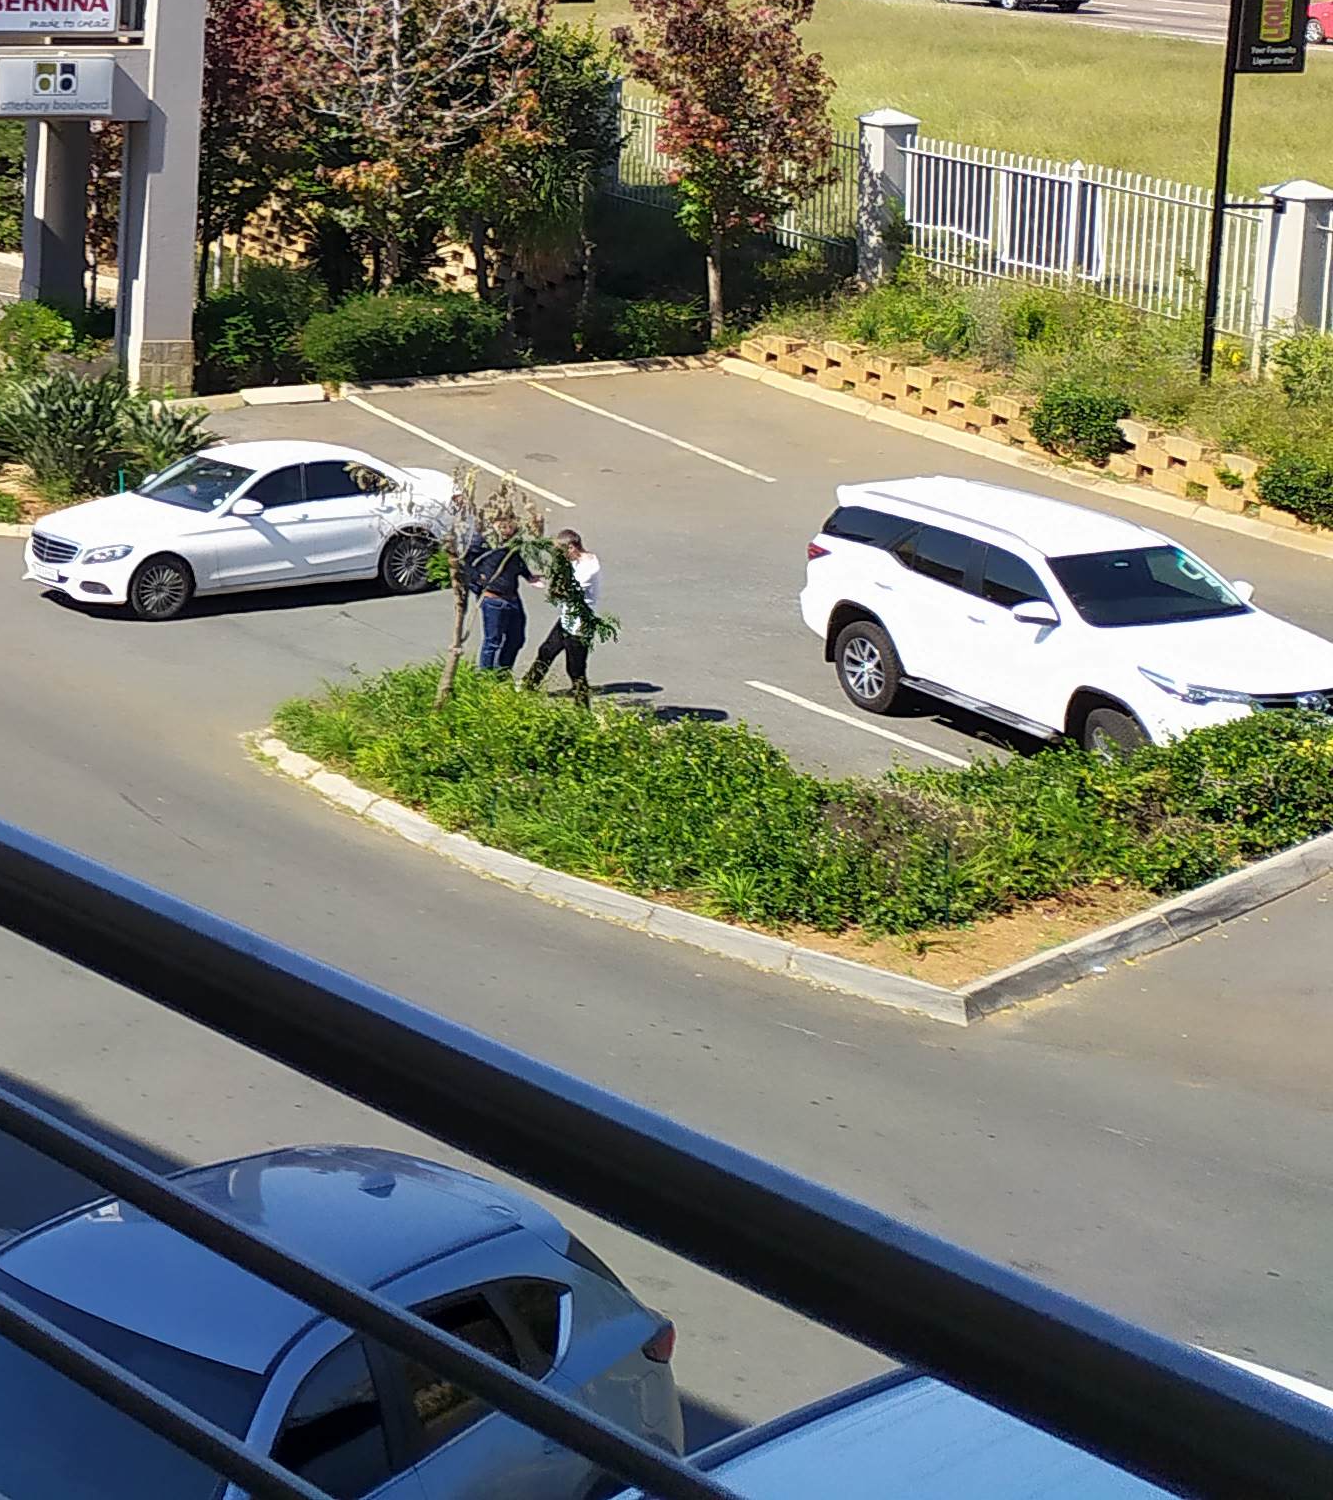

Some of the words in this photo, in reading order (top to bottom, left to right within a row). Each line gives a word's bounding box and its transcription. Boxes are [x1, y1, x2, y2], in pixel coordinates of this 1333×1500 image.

[29, 19, 60, 28] made
[63, 19, 75, 28] to
[77, 17, 110, 28] create
